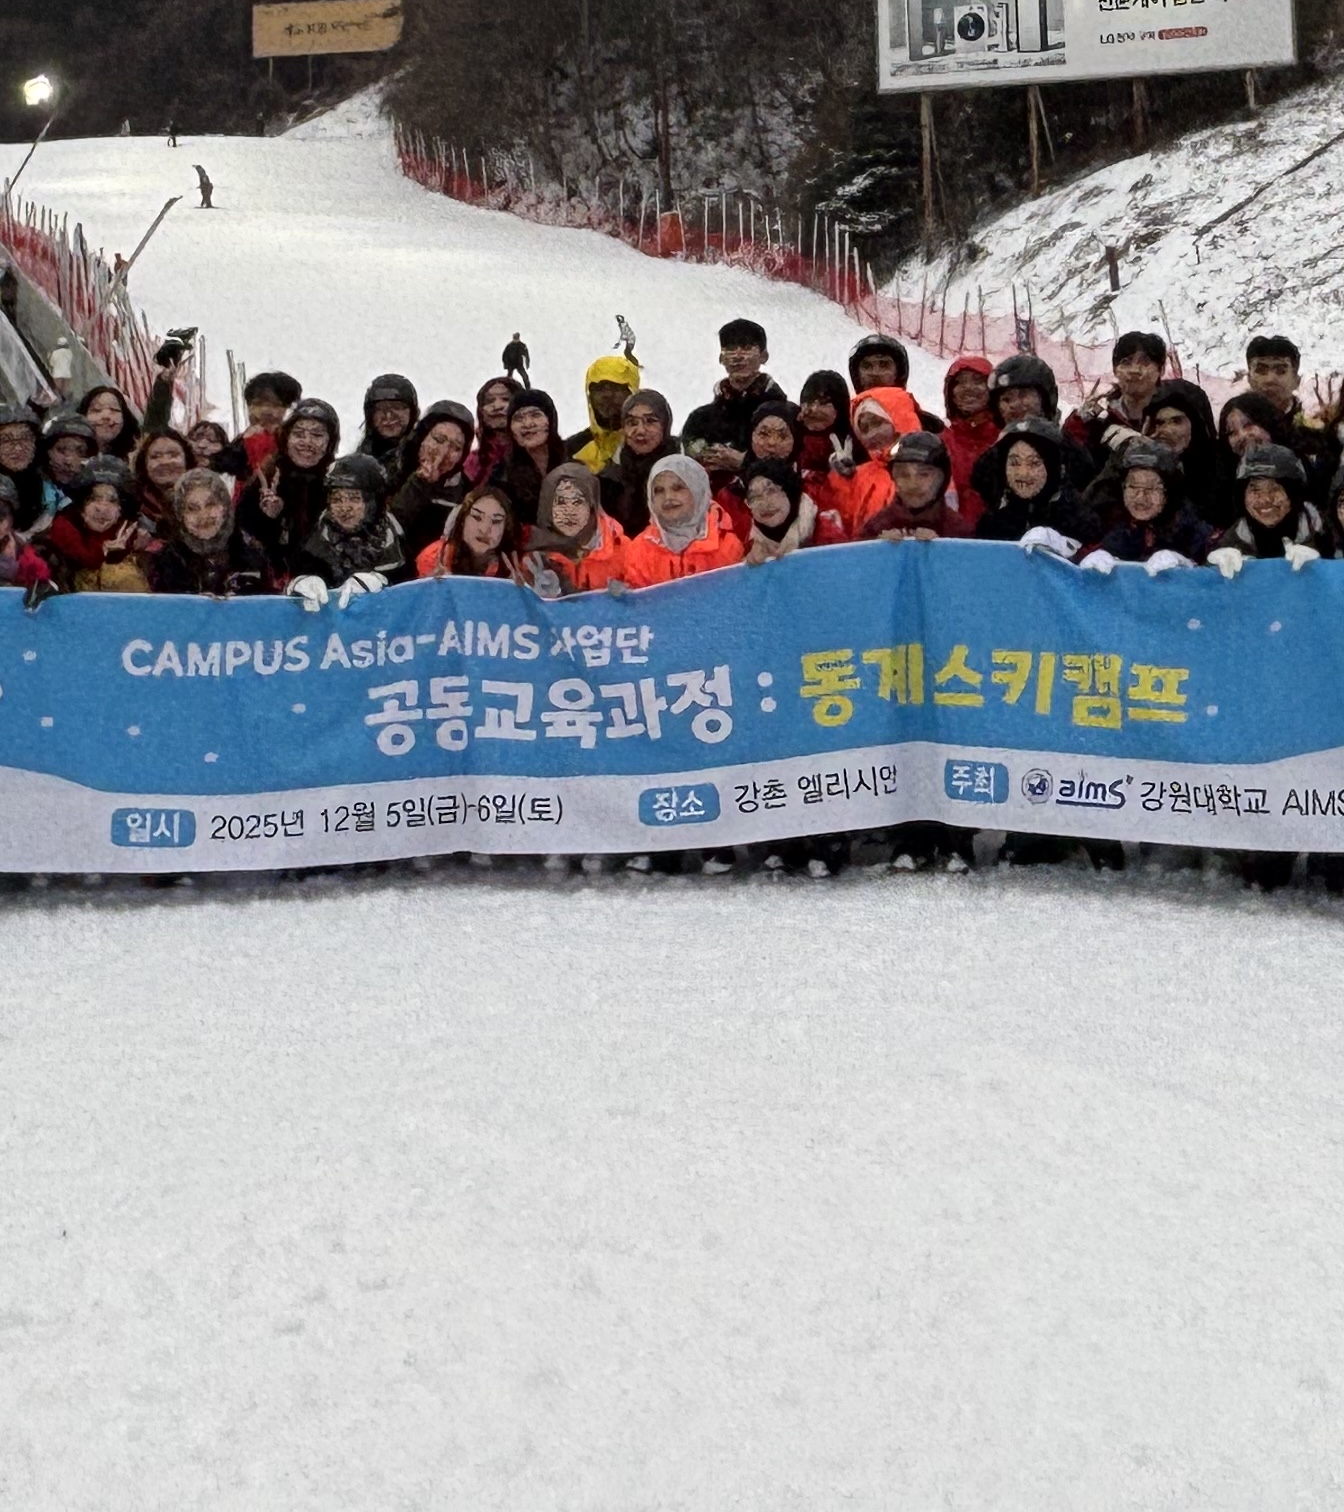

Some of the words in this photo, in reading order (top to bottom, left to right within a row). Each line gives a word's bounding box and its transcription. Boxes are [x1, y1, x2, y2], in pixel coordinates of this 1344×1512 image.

[122, 636, 311, 677] CAMPUS
[320, 619, 540, 669] Asia-AIMS
[550, 625, 655, 667] 사업단
[364, 664, 734, 756] 공동교육과정
[800, 642, 1190, 730] 동계스키캠프
[126, 812, 180, 843] 일시
[210, 809, 304, 840] 2025년
[320, 801, 376, 833] 12월
[652, 787, 706, 822] 장소
[734, 778, 788, 813] 강촌
[1140, 781, 1271, 816] 강원대학교
